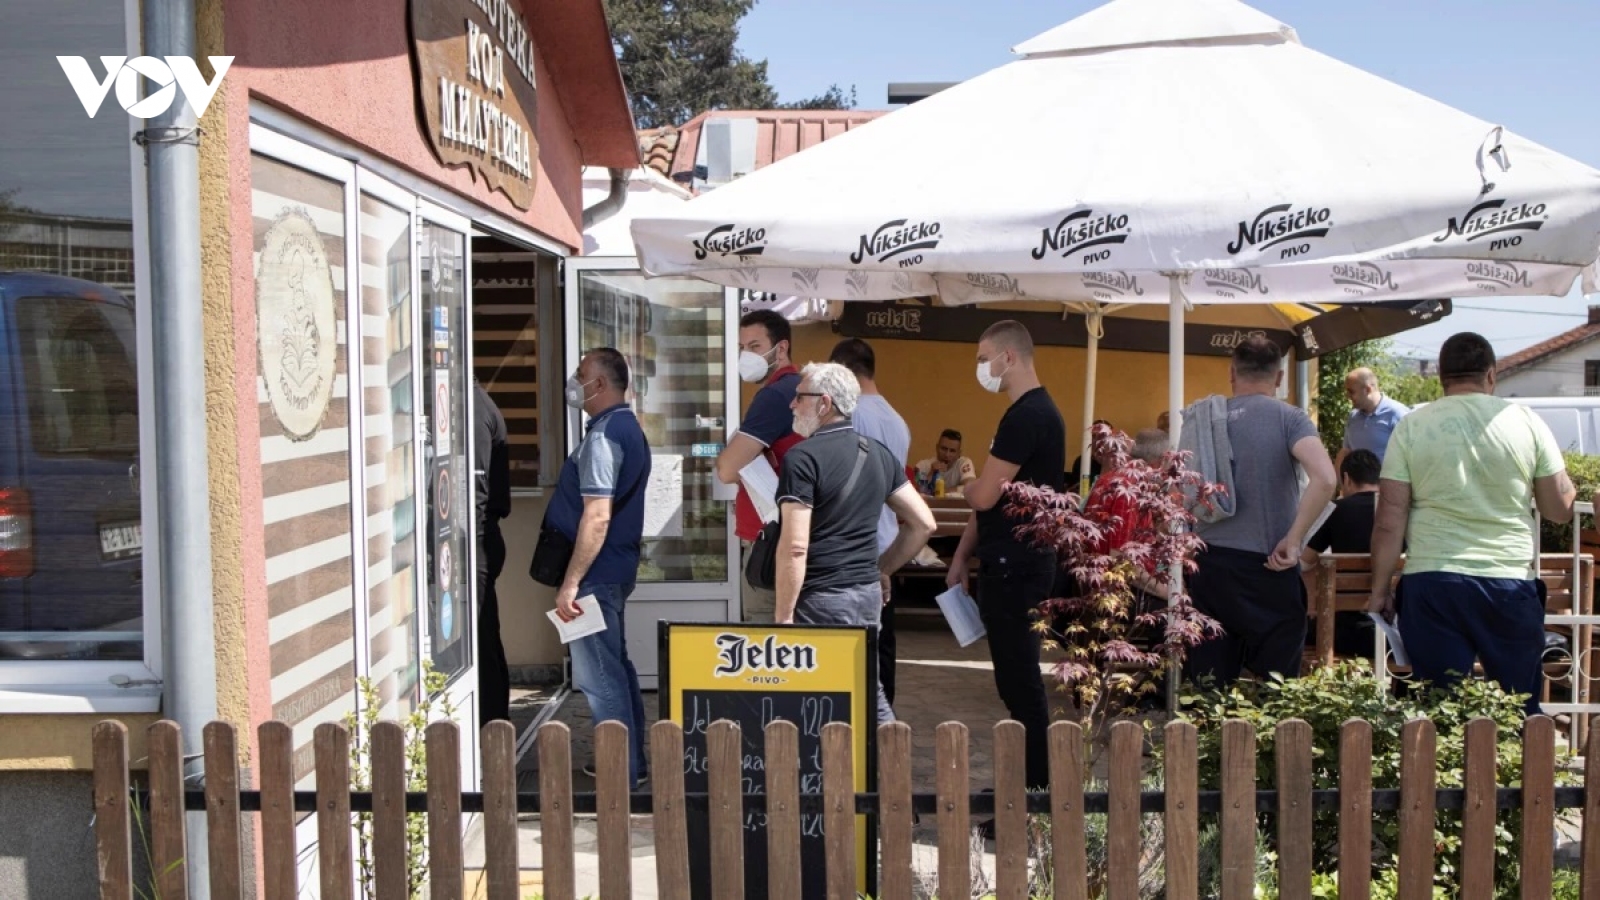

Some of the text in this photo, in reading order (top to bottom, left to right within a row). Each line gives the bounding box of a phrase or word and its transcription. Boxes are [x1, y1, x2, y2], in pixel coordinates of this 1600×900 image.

[467, 18, 505, 98] КОД
[440, 76, 532, 179] МИЛУТИНА
[1280, 243, 1310, 259] PIVO
[1490, 236, 1522, 251] PIVO
[899, 254, 923, 268] PIVO
[1083, 249, 1111, 265] PIVO
[715, 633, 817, 676] Jelen
[752, 676, 780, 684] PIVO
